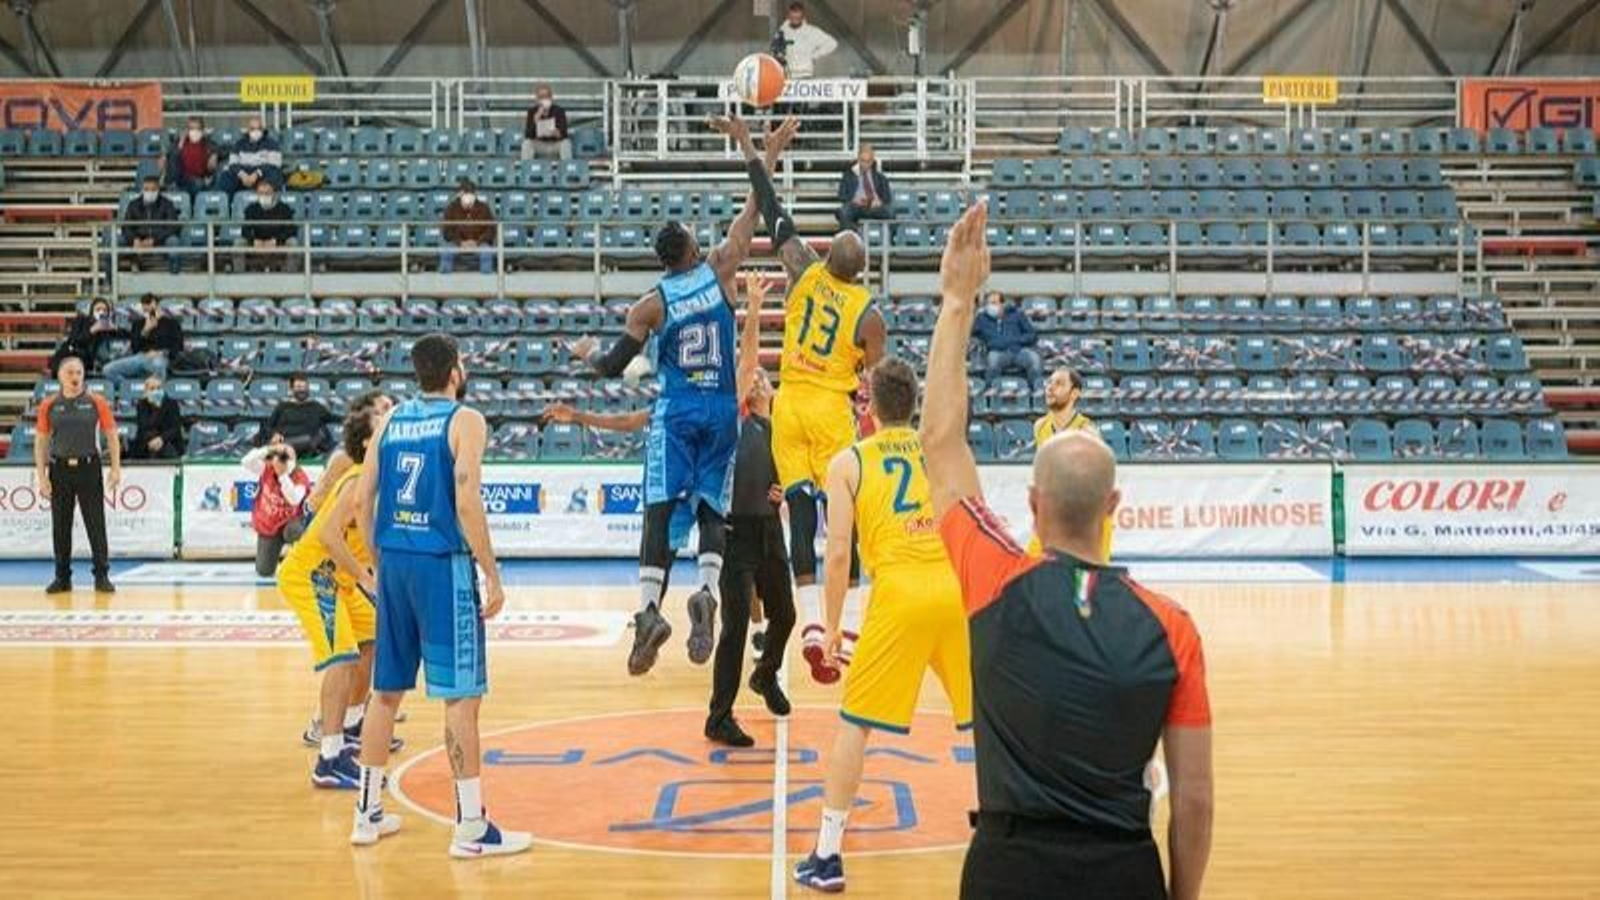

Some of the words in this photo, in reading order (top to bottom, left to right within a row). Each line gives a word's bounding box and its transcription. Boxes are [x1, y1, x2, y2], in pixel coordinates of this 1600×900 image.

[726, 83, 834, 97] PZIONE
[840, 84, 860, 97] TV
[678, 322, 722, 368] 21
[797, 296, 841, 357] 13
[396, 451, 425, 505] 7
[1363, 479, 1527, 512] COLORI
[1547, 491, 1567, 512] e
[1111, 506, 1174, 529] GNE
[1184, 503, 1324, 529] LUMINOSE
[1361, 525, 1396, 537] Via
[457, 588, 475, 672] BASKET
